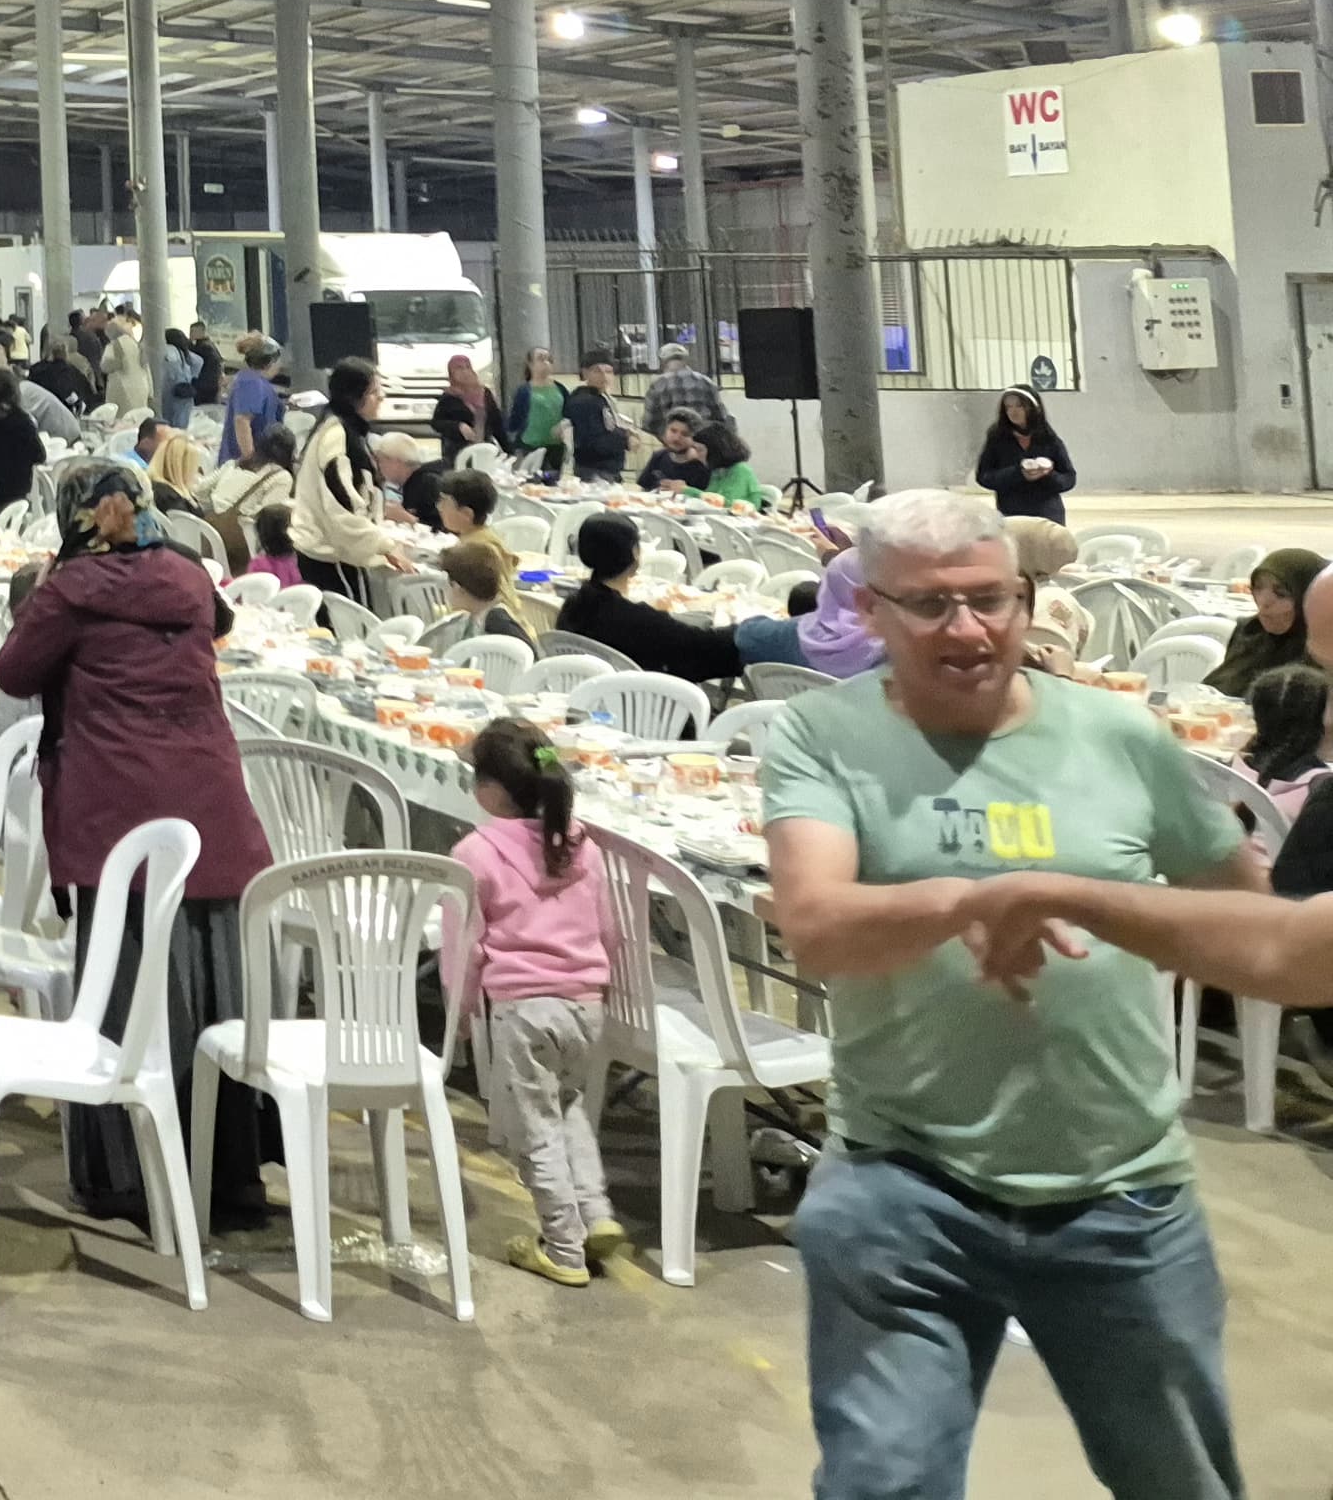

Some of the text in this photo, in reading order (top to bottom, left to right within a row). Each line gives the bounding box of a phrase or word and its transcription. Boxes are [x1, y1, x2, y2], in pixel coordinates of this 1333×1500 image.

[1008, 90, 1060, 125] WC
[1008, 141, 1068, 154] BAY BAYAN
